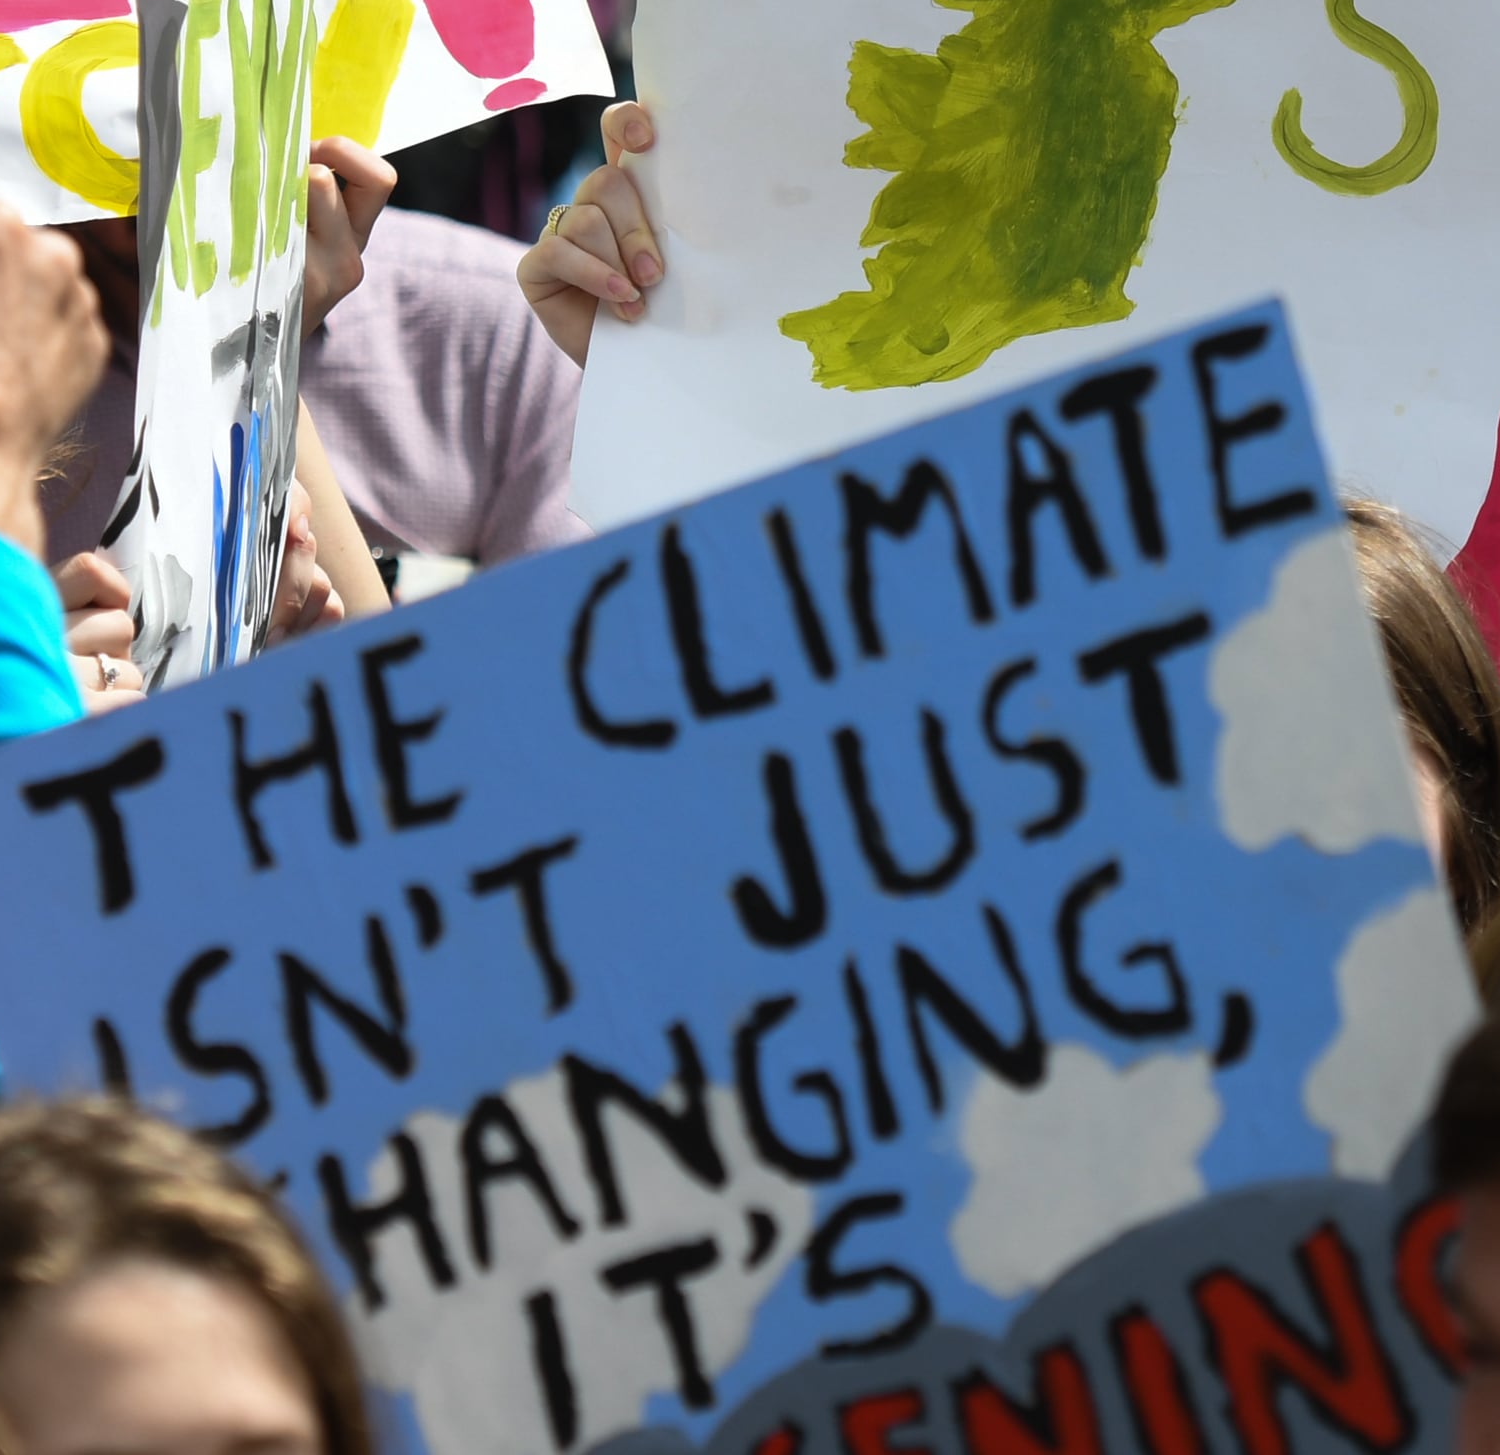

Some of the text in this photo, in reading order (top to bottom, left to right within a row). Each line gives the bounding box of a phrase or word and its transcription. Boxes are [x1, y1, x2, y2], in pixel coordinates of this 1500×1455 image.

[18, 324, 1317, 916] THE CLIMATE
[730, 612, 1213, 952] JUST
[275, 856, 1256, 1318] HANGING,
[524, 1191, 932, 1452] IT'S
